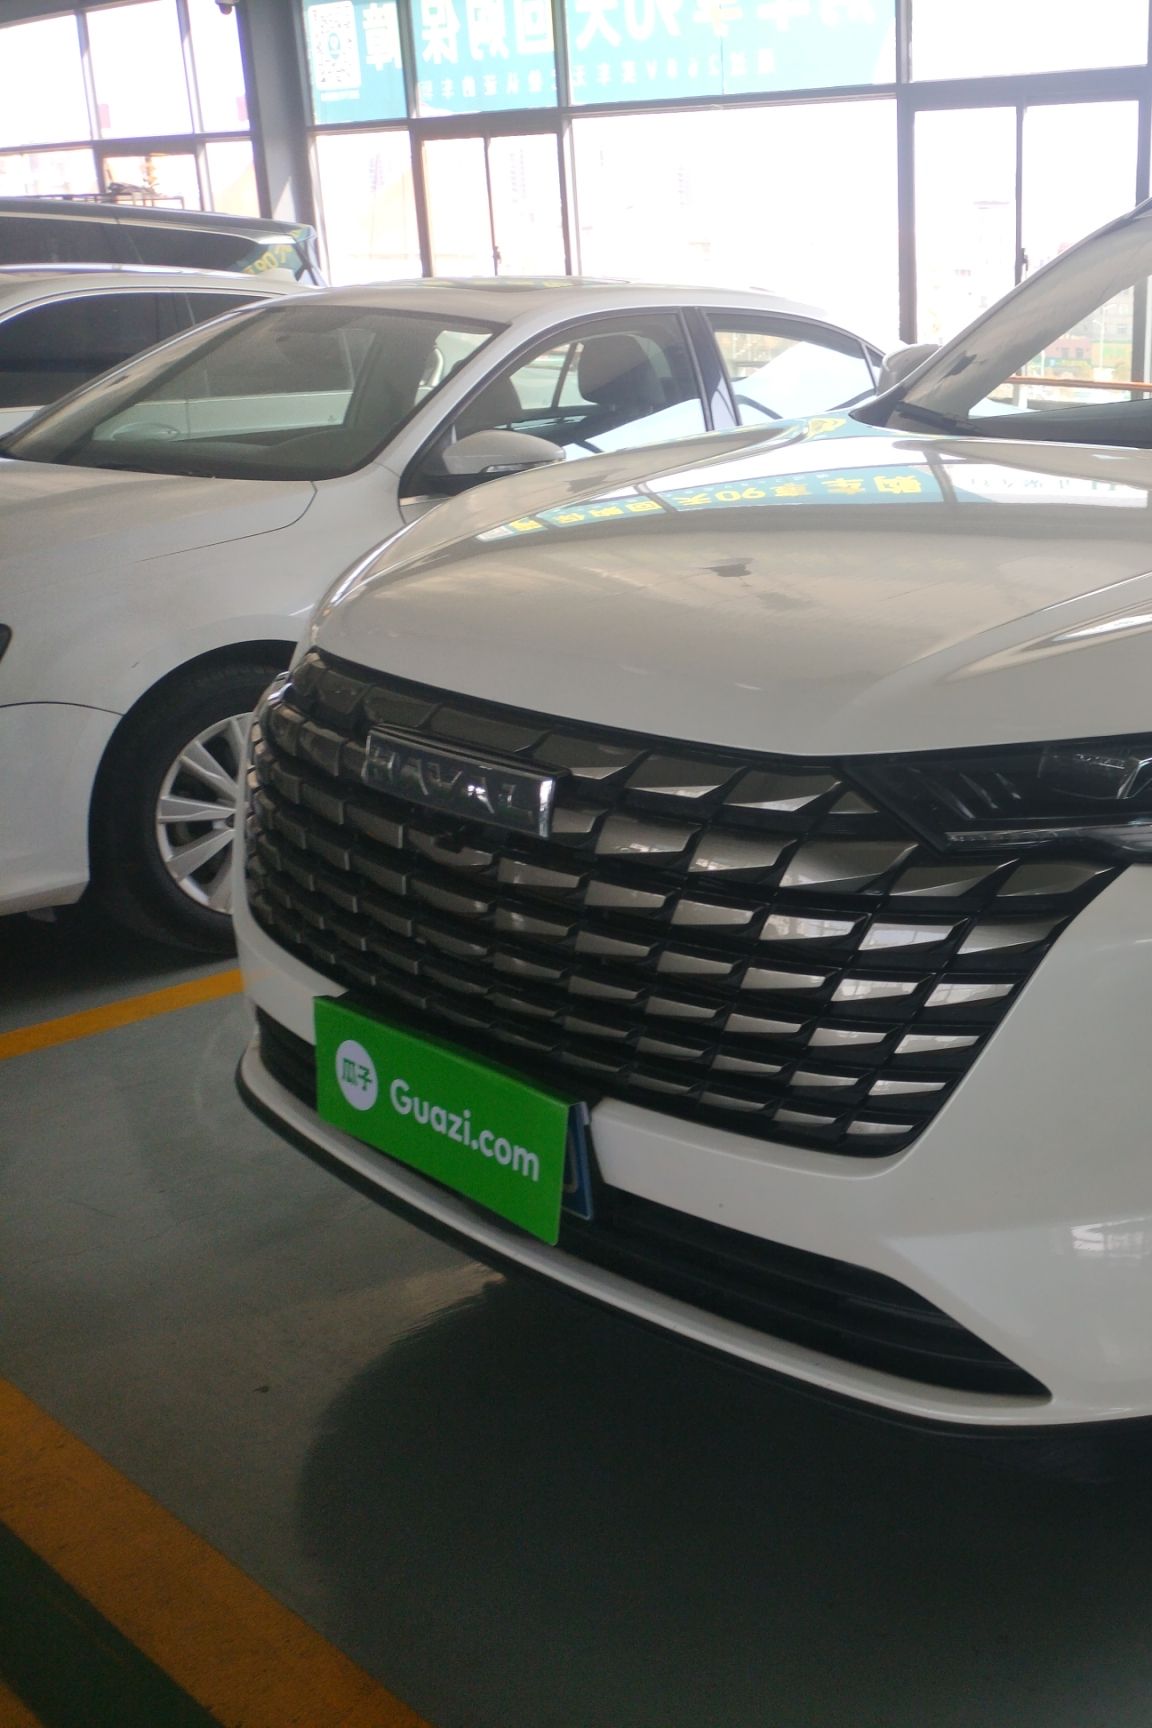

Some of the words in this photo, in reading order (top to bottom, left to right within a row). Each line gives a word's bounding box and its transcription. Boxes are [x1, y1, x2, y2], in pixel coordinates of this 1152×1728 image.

[371, 745, 534, 826] HAVAL
[341, 1058, 372, 1091] 瓜子
[389, 1078, 540, 1182] Guazi.com
